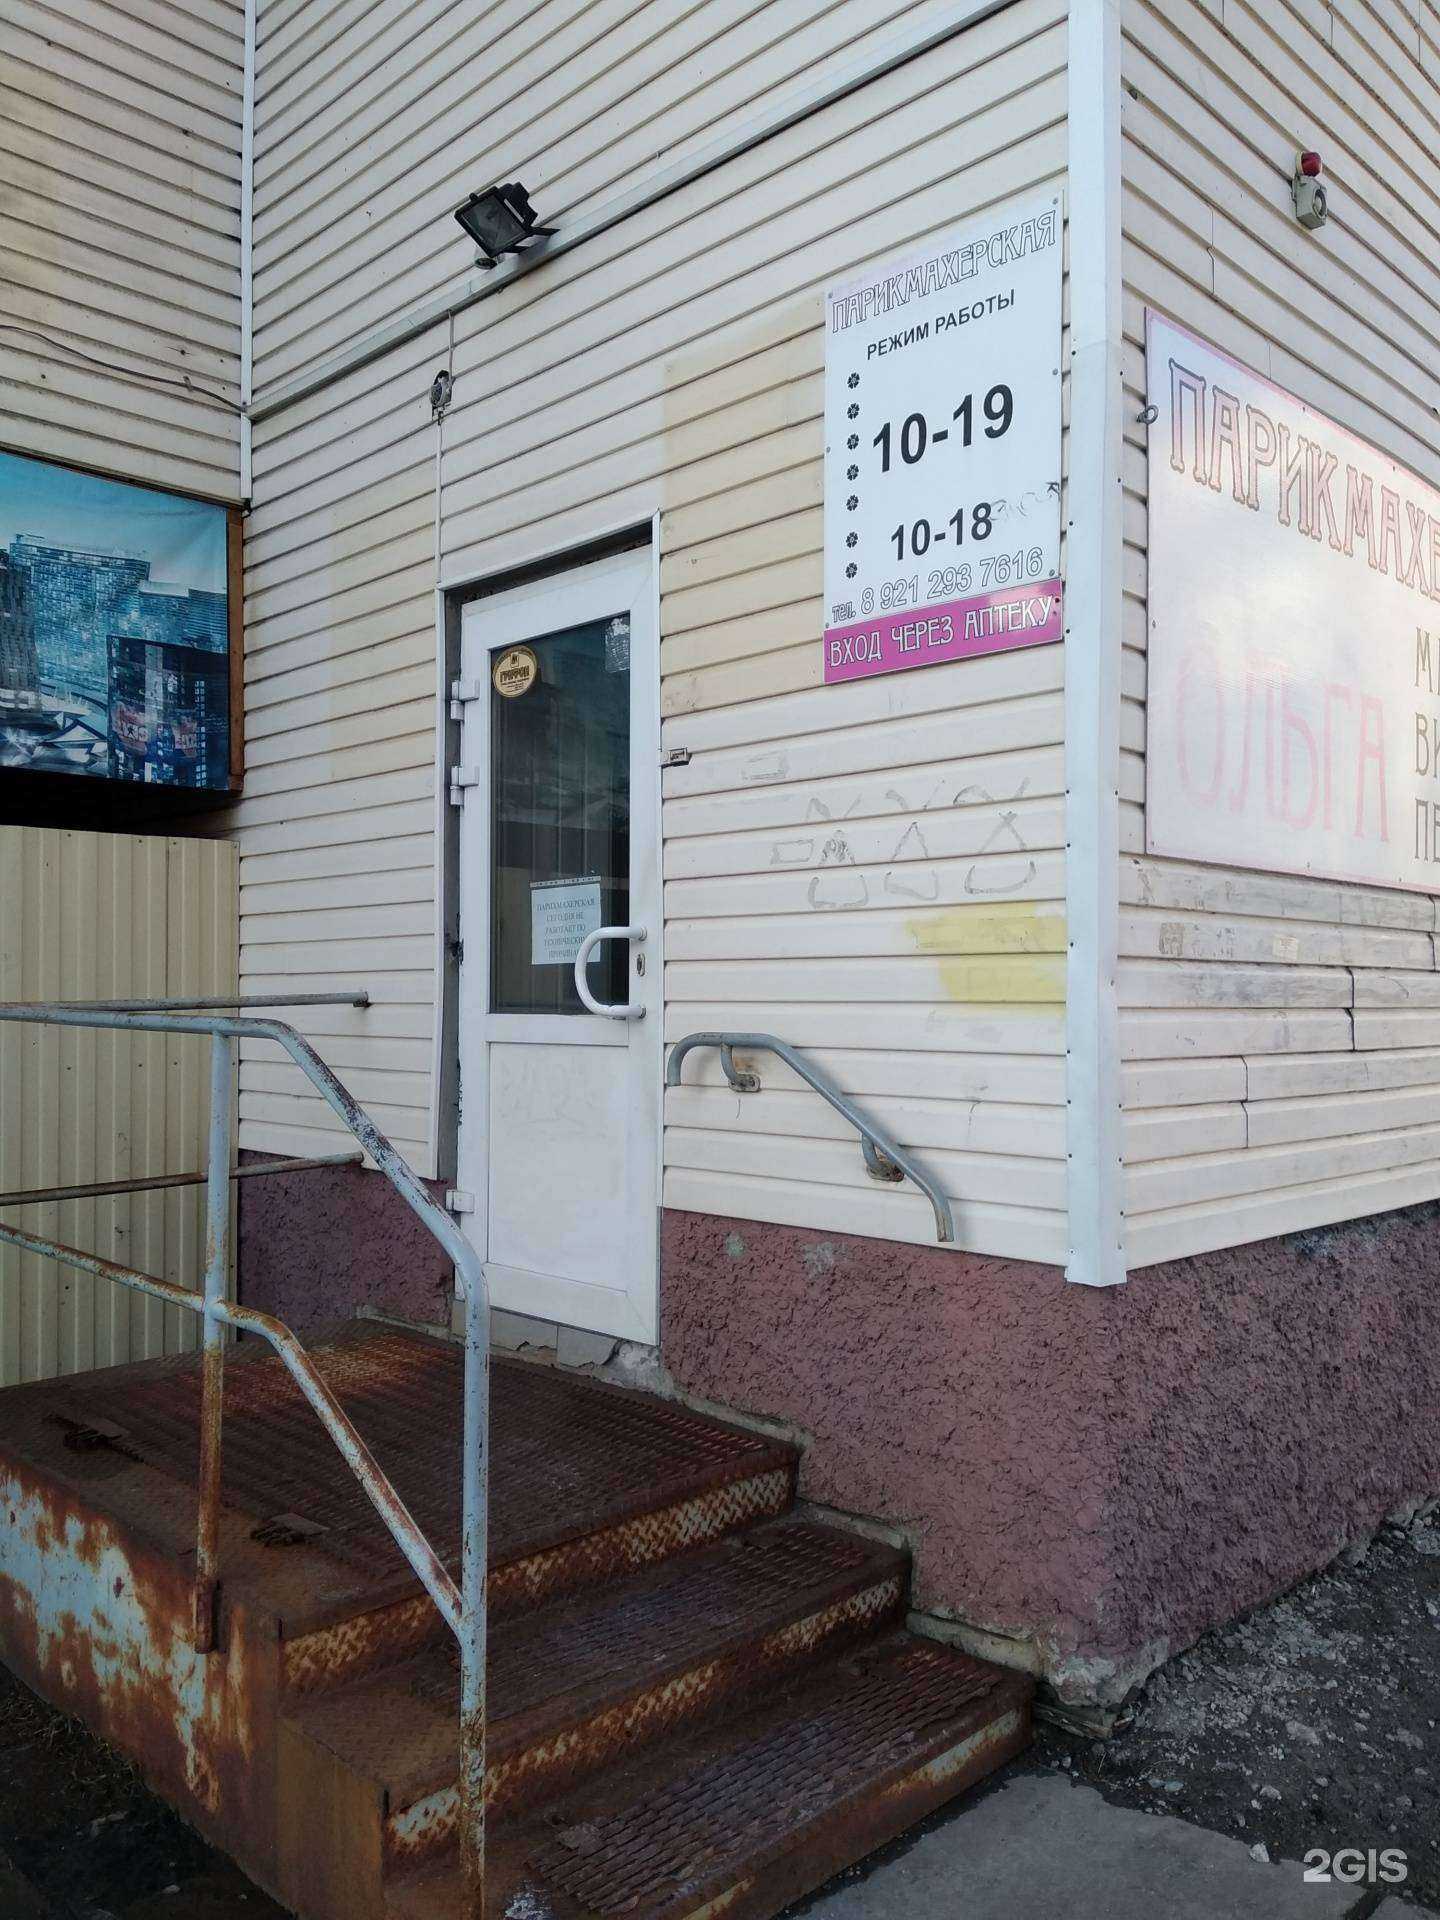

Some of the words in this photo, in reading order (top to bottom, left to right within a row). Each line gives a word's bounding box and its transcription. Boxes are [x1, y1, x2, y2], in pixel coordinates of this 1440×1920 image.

[832, 210, 1056, 333] ПАРИКМАХЕРСКАЯ
[867, 322, 929, 360] РЕЖИМ
[935, 289, 1015, 334] РАБОТЫ
[873, 384, 1013, 472] 10-19
[891, 502, 992, 560] 10-18
[832, 601, 856, 623] тел.
[861, 588, 874, 614] 8
[880, 575, 919, 609] 921
[927, 564, 972, 599] 293
[980, 547, 1043, 586] 7616
[829, 633, 882, 667] ВХОД
[891, 615, 953, 654] ЧЕРЕЗ
[964, 595, 1054, 640] АПТЕКУ
[1176, 640, 1389, 842] ОЛЬГА
